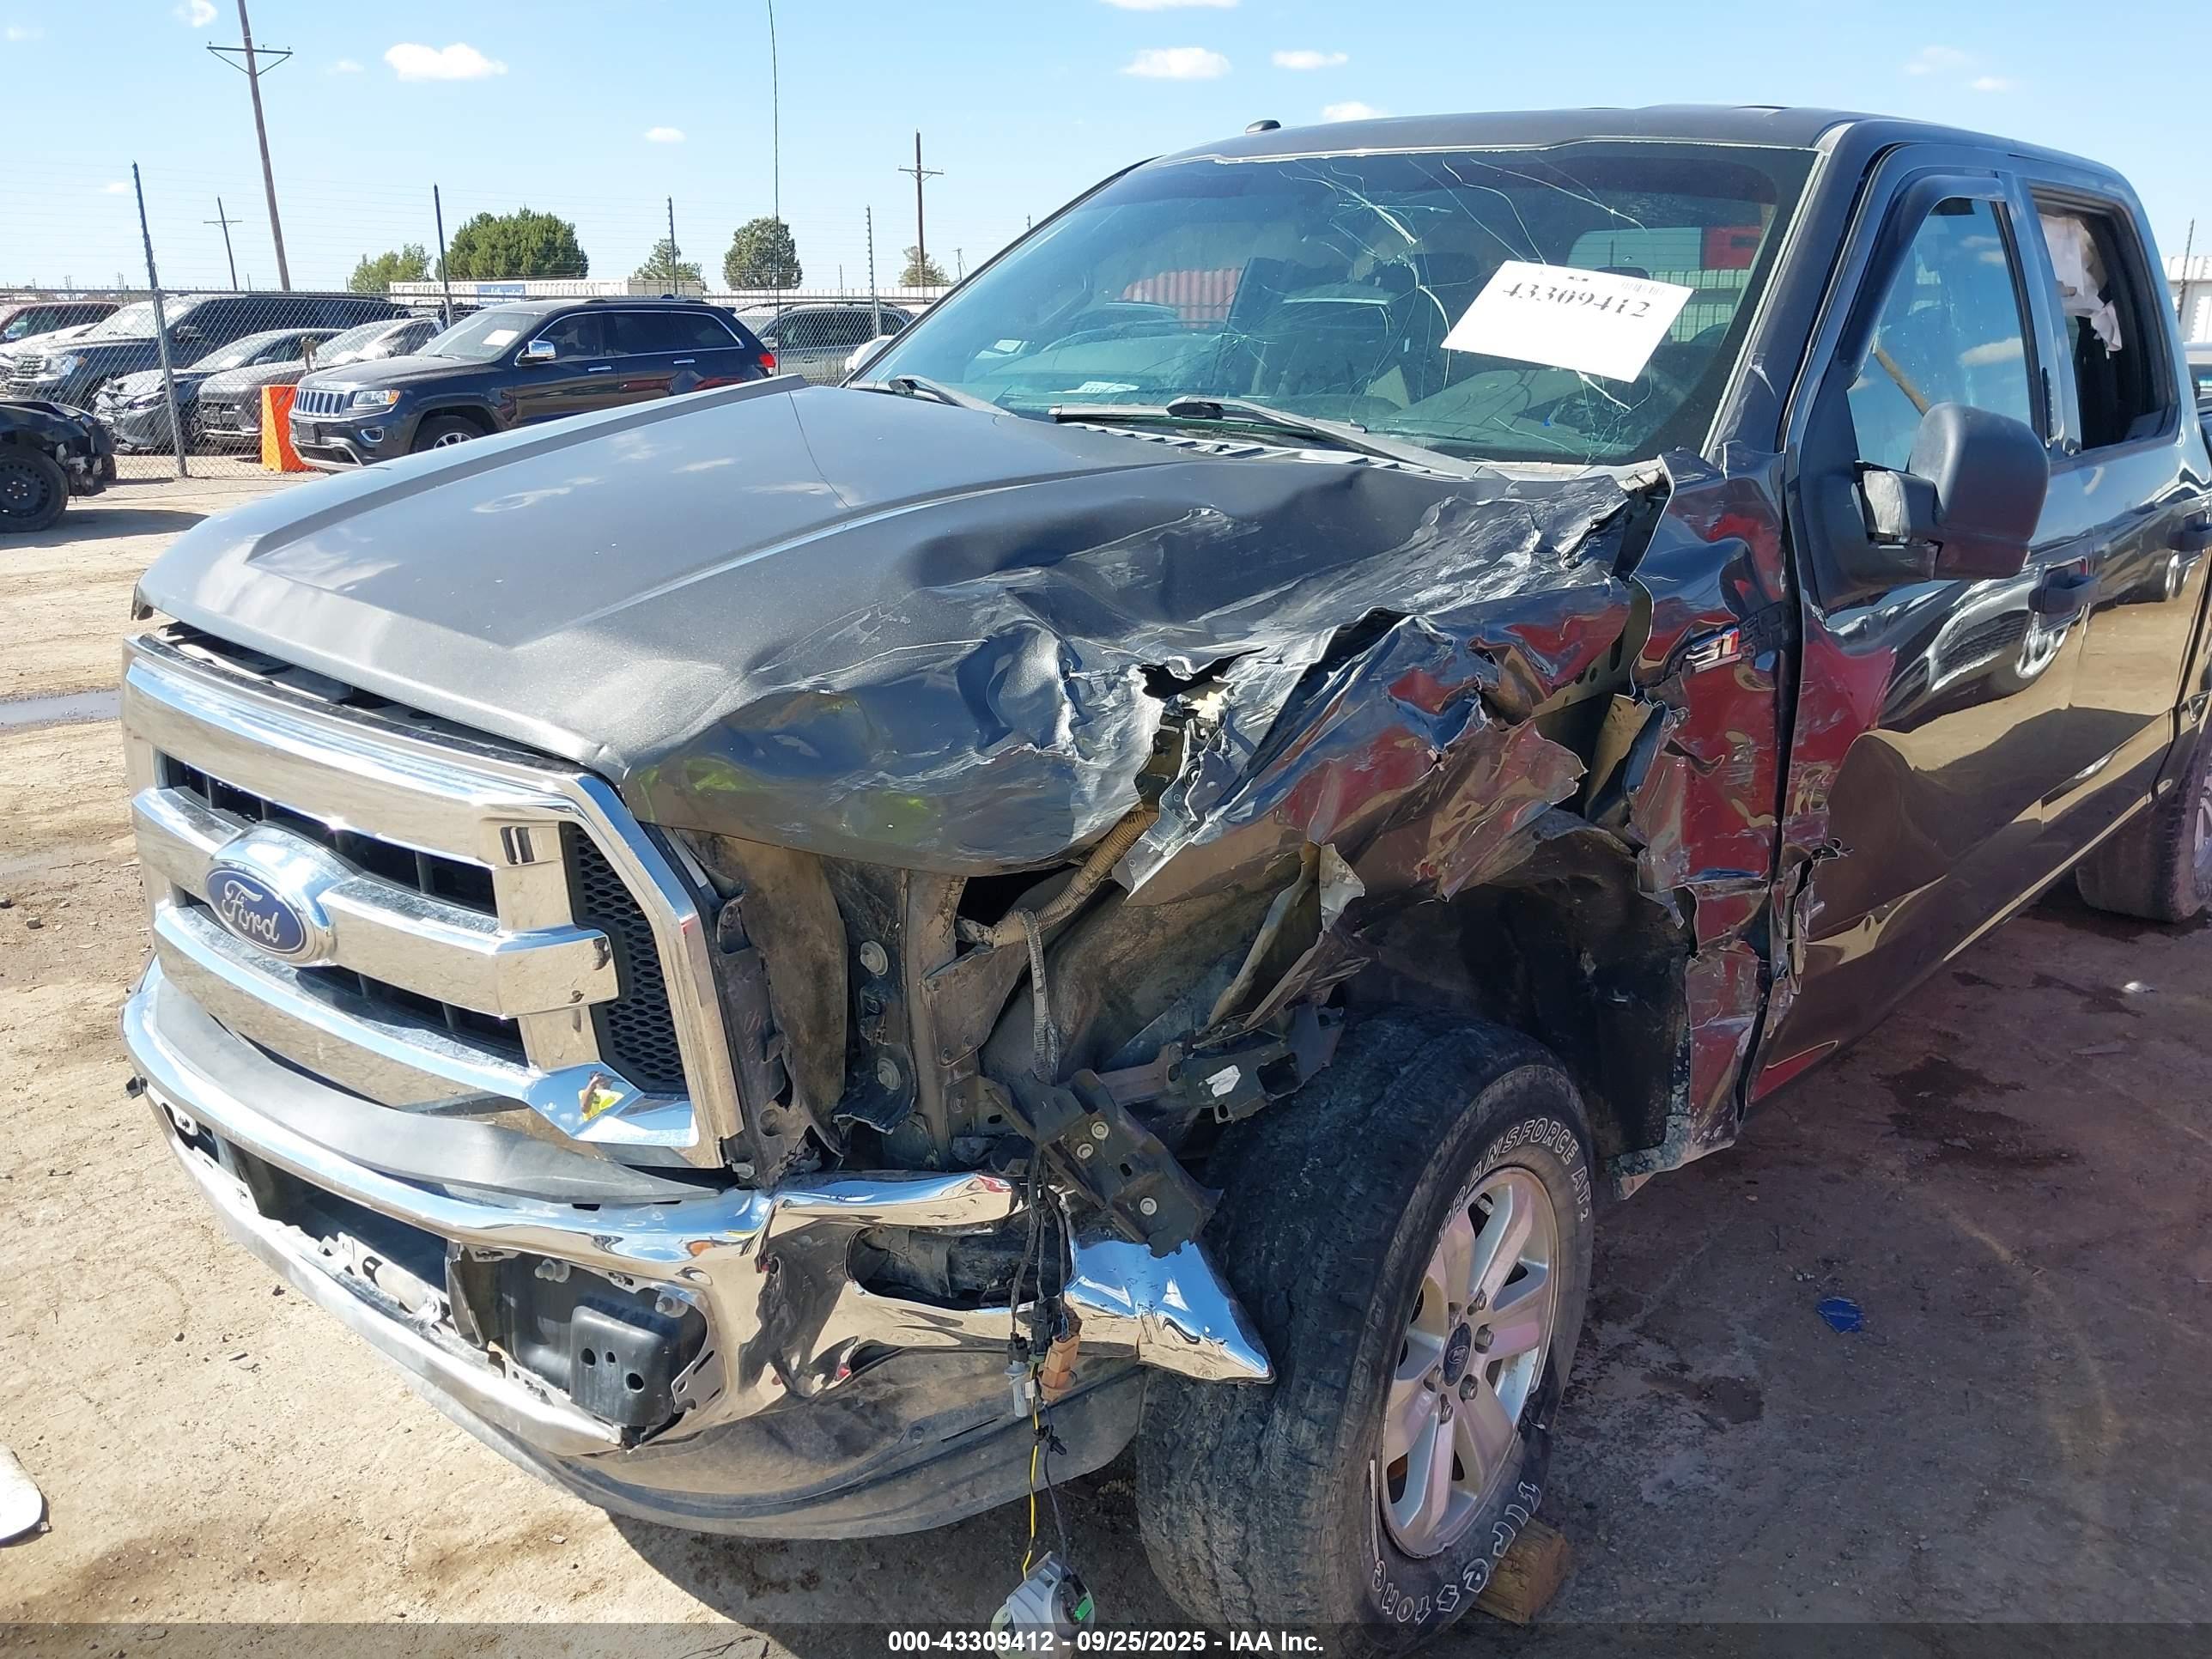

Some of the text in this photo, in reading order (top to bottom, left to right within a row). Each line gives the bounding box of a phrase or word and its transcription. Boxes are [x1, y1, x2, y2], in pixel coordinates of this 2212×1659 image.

[1503, 282, 1650, 318] 43309412
[222, 879, 280, 943] Ford
[1439, 1117, 1592, 1243] TRANSFORCE AT 2
